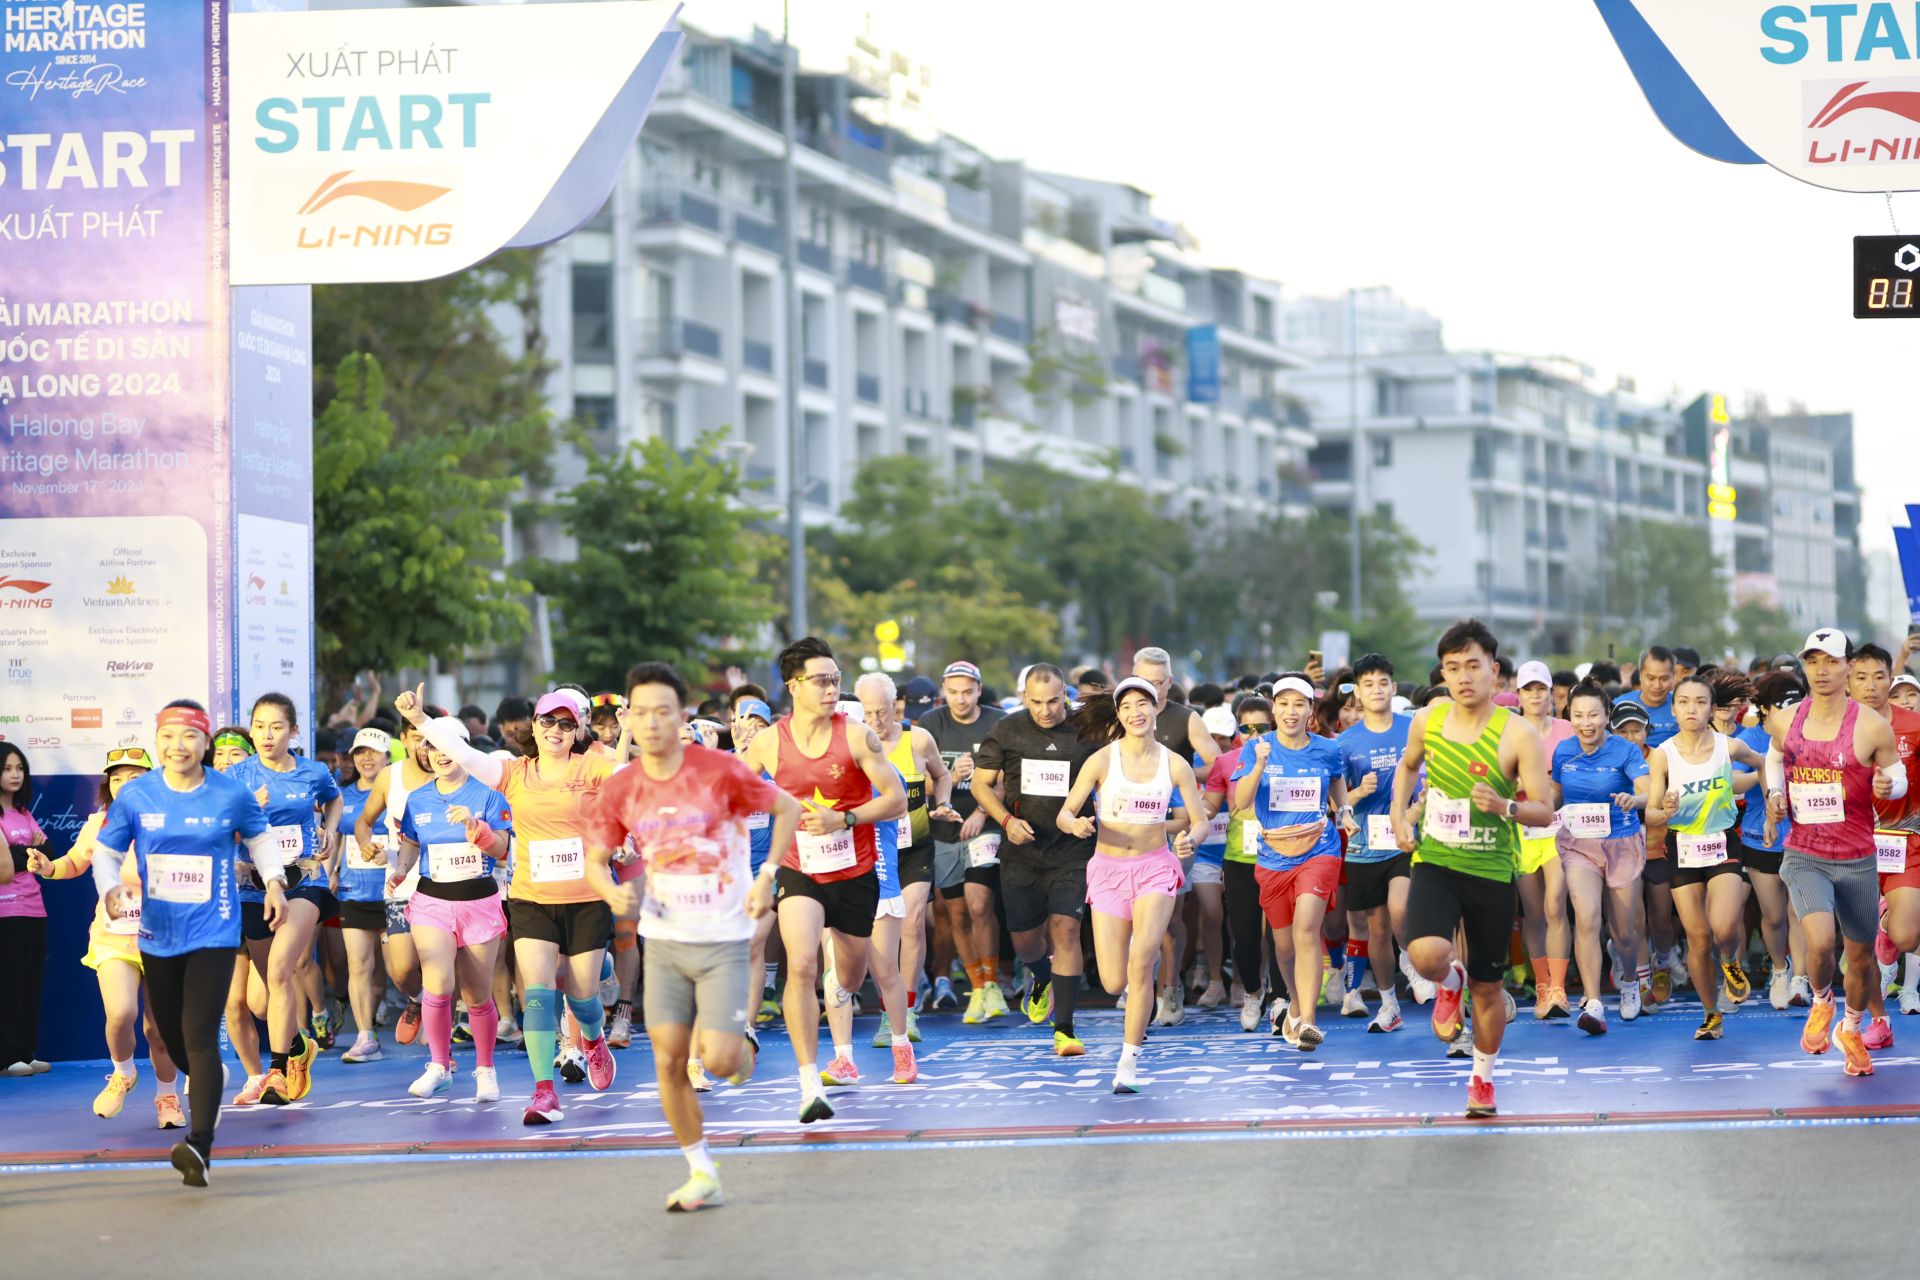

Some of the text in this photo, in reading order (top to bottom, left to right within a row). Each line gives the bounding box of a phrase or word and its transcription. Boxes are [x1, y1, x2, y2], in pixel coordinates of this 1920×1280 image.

[5, 2, 146, 31] HERITAGE
[5, 29, 146, 53] MARATHON
[1759, 2, 1920, 65] STA
[54, 55, 79, 65] SINCE
[211, 2, 222, 106] HALONG BAY HERITAGE
[286, 42, 459, 78] XUẤT PHÁT
[5, 62, 95, 101] Heritage
[254, 92, 491, 154] START
[212, 123, 222, 144] SITE
[0, 129, 196, 190] TART
[212, 144, 222, 189] HERITAGE
[213, 190, 222, 229] UNESCO
[83, 204, 163, 239] PHÁT
[296, 223, 453, 249] LI-NING
[27, 299, 193, 326] MARATHON
[55, 330, 90, 361] TẾ
[96, 336, 124, 361] DI
[130, 329, 190, 360] SẢN
[22, 372, 101, 399] LONG
[107, 371, 181, 397] 2024
[9, 411, 147, 440] Halong Bay
[75, 447, 191, 472] Marathon
[12, 481, 79, 495] November
[109, 479, 145, 493] 2024
[112, 547, 143, 557] Official
[19, 560, 52, 569] Sponsor
[99, 559, 157, 568] Airline Partner
[214, 567, 223, 577] DI
[215, 620, 225, 673] MARATHON
[8, 667, 33, 679] true
[106, 660, 154, 672] ReVive
[214, 674, 225, 694] GIẢI
[62, 693, 97, 702] Partners
[1039, 772, 1065, 782] 13062
[1799, 767, 1831, 783] YEARS
[1290, 789, 1316, 798] 19707
[1681, 776, 1724, 797] XRC
[1134, 799, 1161, 810] 10691
[1807, 797, 1837, 807] 12536
[1581, 815, 1606, 824] 13493
[279, 839, 298, 849] 172
[819, 839, 850, 854] 15468
[1696, 842, 1722, 853] 14956
[449, 854, 477, 866] 18743
[549, 852, 579, 864] 17087
[171, 872, 204, 883] 17982
